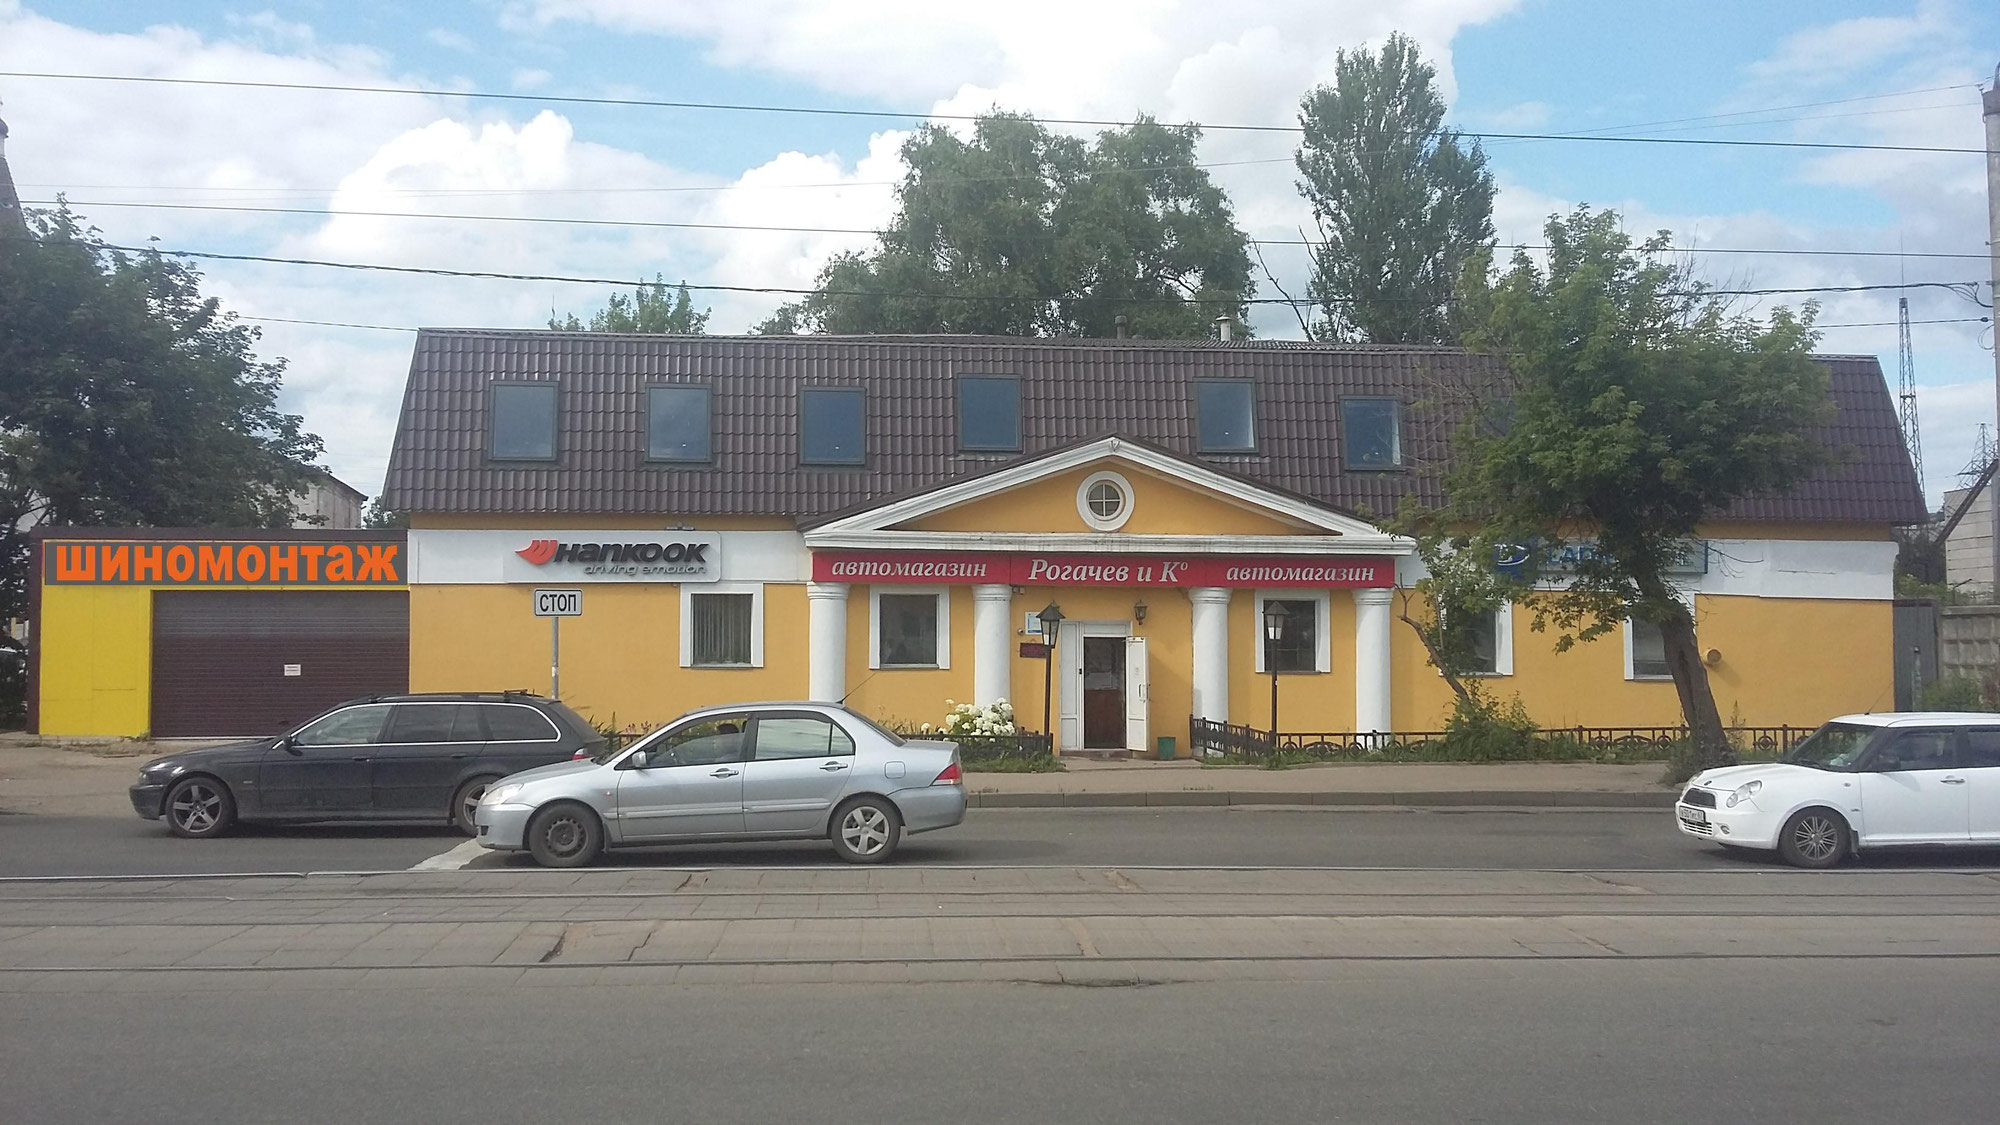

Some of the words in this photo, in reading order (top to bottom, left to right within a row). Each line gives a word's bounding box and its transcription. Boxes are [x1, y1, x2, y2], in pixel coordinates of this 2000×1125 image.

[584, 565, 638, 576] driving
[642, 566, 707, 575] emotion
[831, 561, 987, 577] автомагазин
[1028, 559, 1129, 581] Рогачев
[1136, 567, 1152, 581] и
[1226, 566, 1375, 581] автомагазин
[539, 594, 577, 612] СТОП
